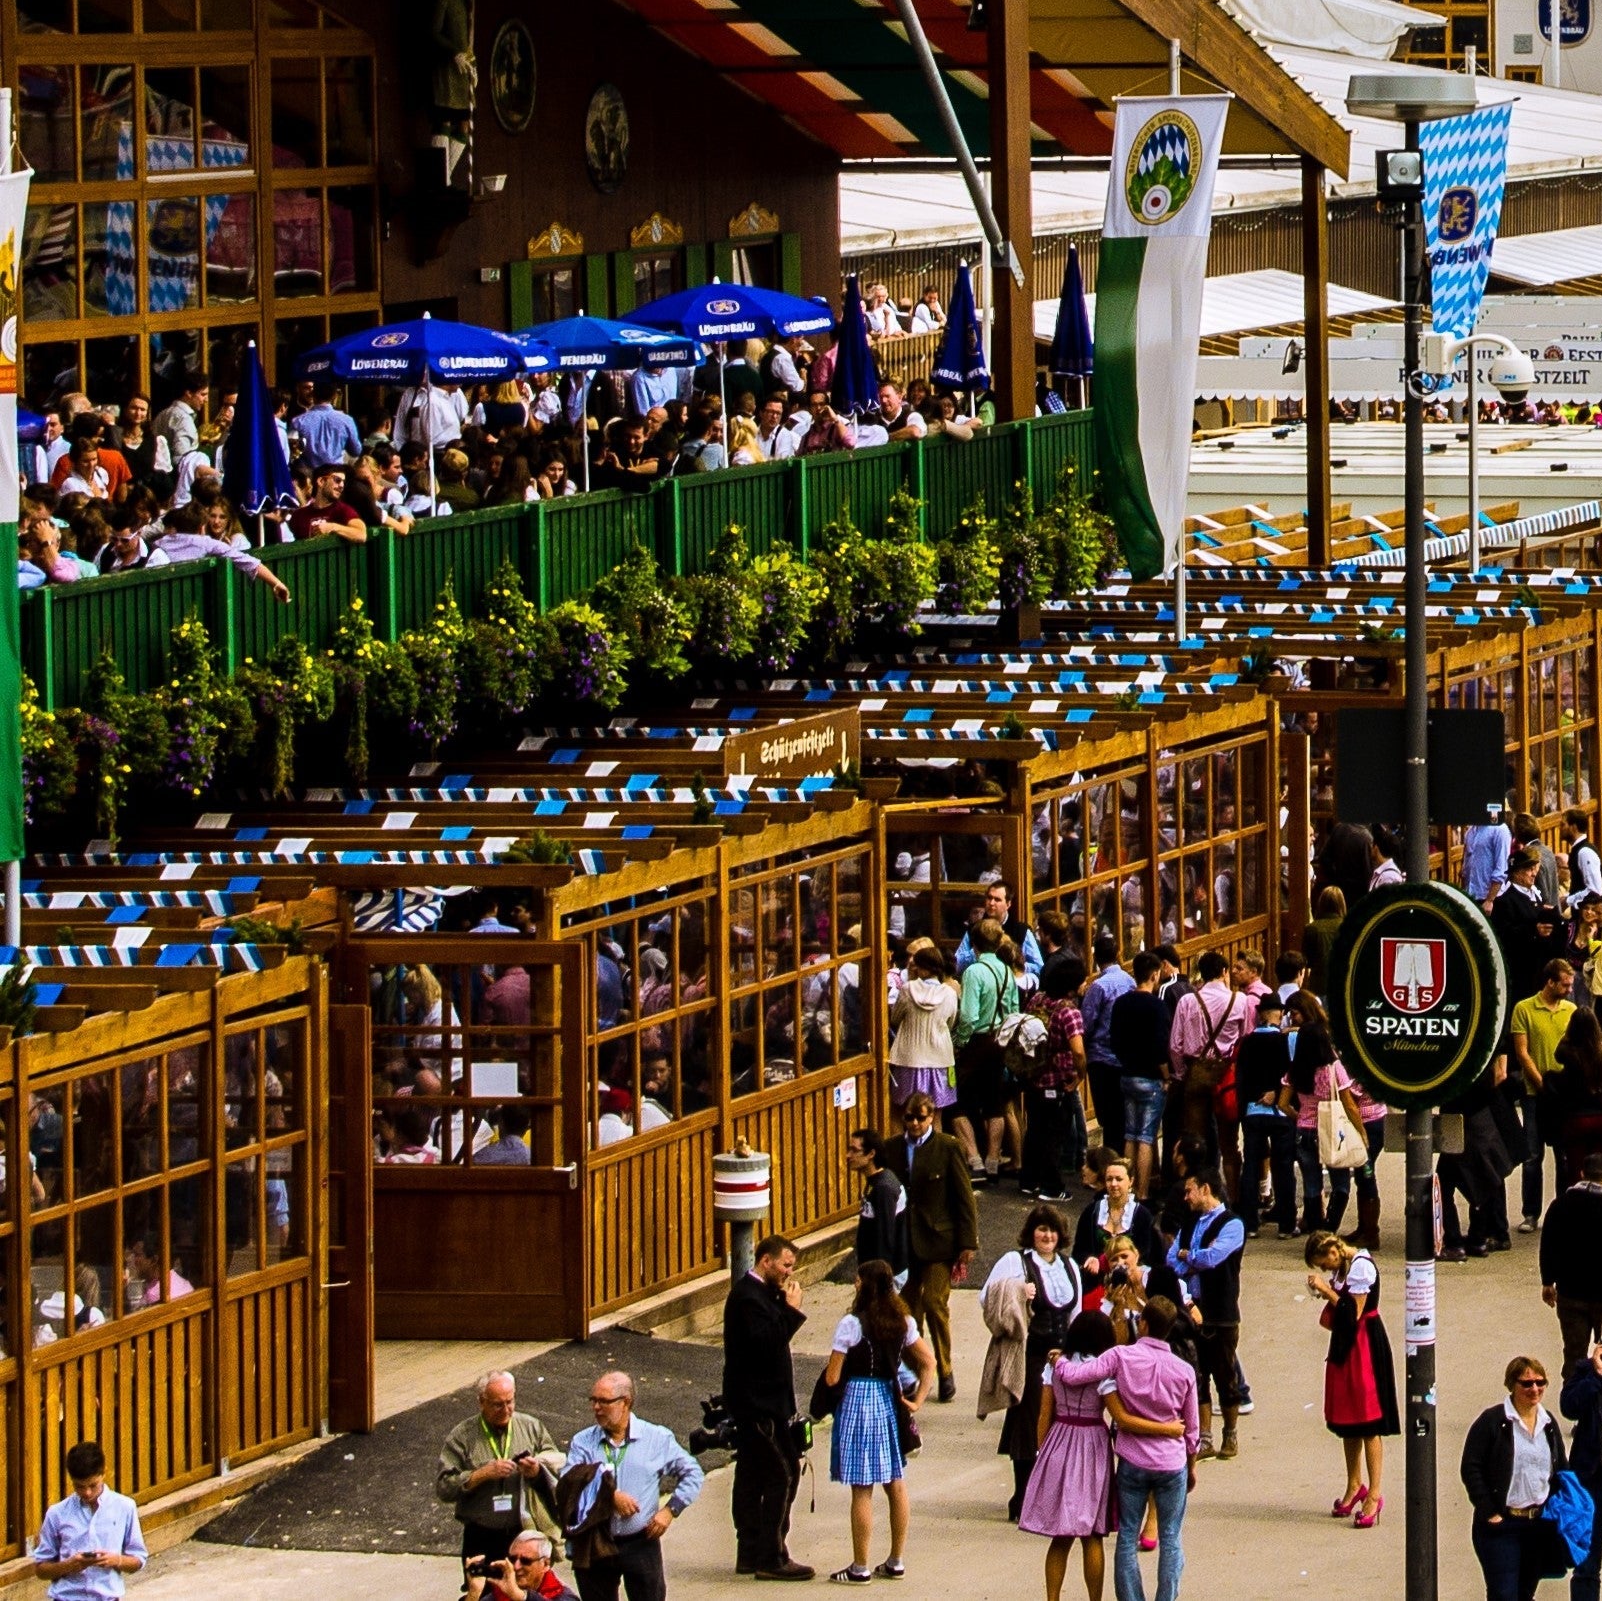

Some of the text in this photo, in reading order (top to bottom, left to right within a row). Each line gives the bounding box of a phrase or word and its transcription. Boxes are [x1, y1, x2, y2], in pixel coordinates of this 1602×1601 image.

[1533, 369, 1591, 385] STZELT
[1392, 989, 1433, 1002] G S
[1365, 1016, 1460, 1037] SPATEN
[1383, 1039, 1440, 1052] München
